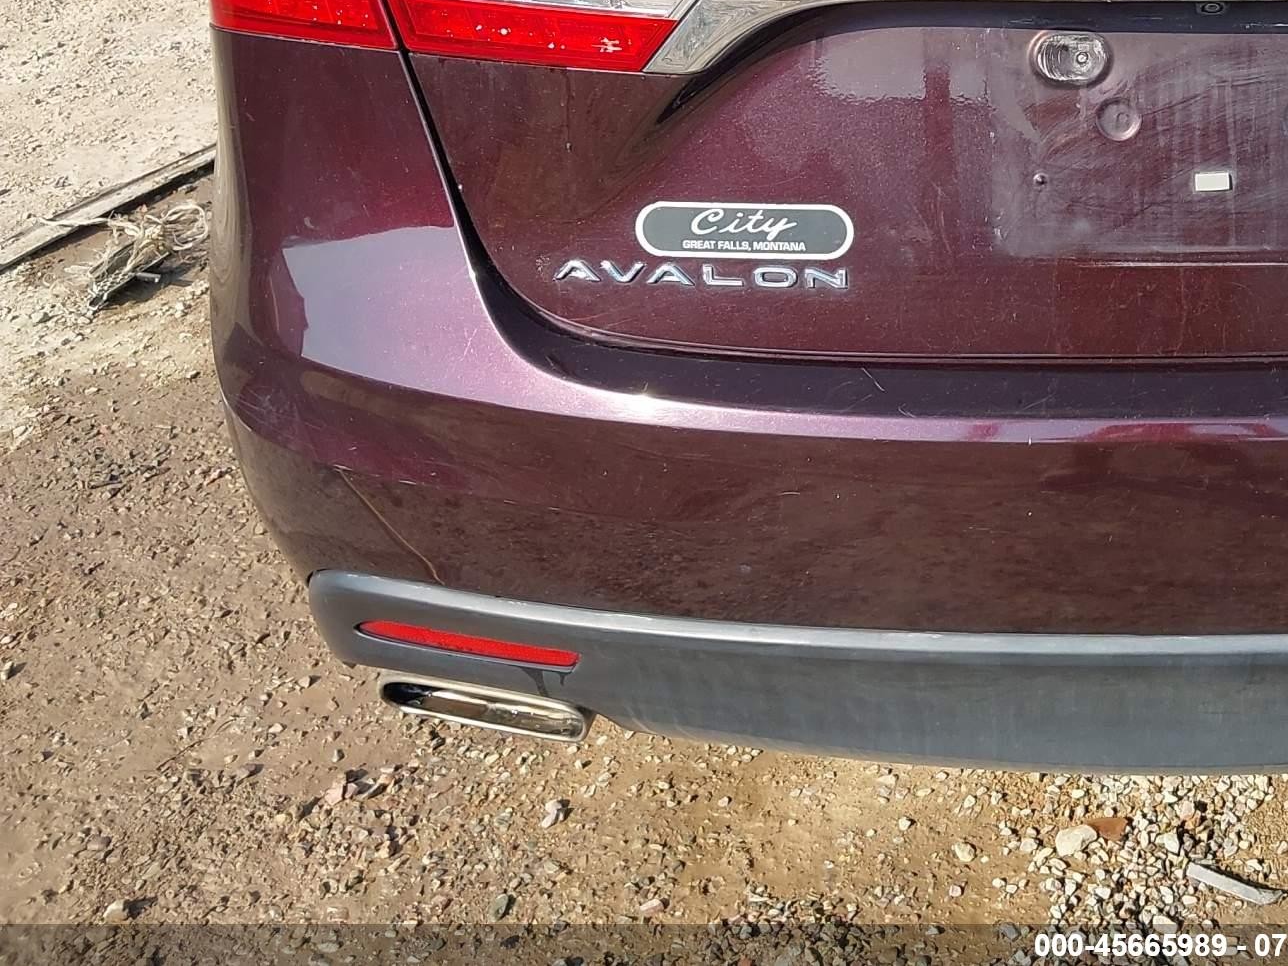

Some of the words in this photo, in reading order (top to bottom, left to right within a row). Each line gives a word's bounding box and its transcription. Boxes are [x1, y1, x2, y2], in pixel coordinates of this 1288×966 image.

[690, 208, 797, 241] City
[682, 240, 716, 251] GREAT
[717, 240, 752, 252] FALLS,
[753, 240, 806, 252] MONTANA
[553, 259, 850, 290] AVALON
